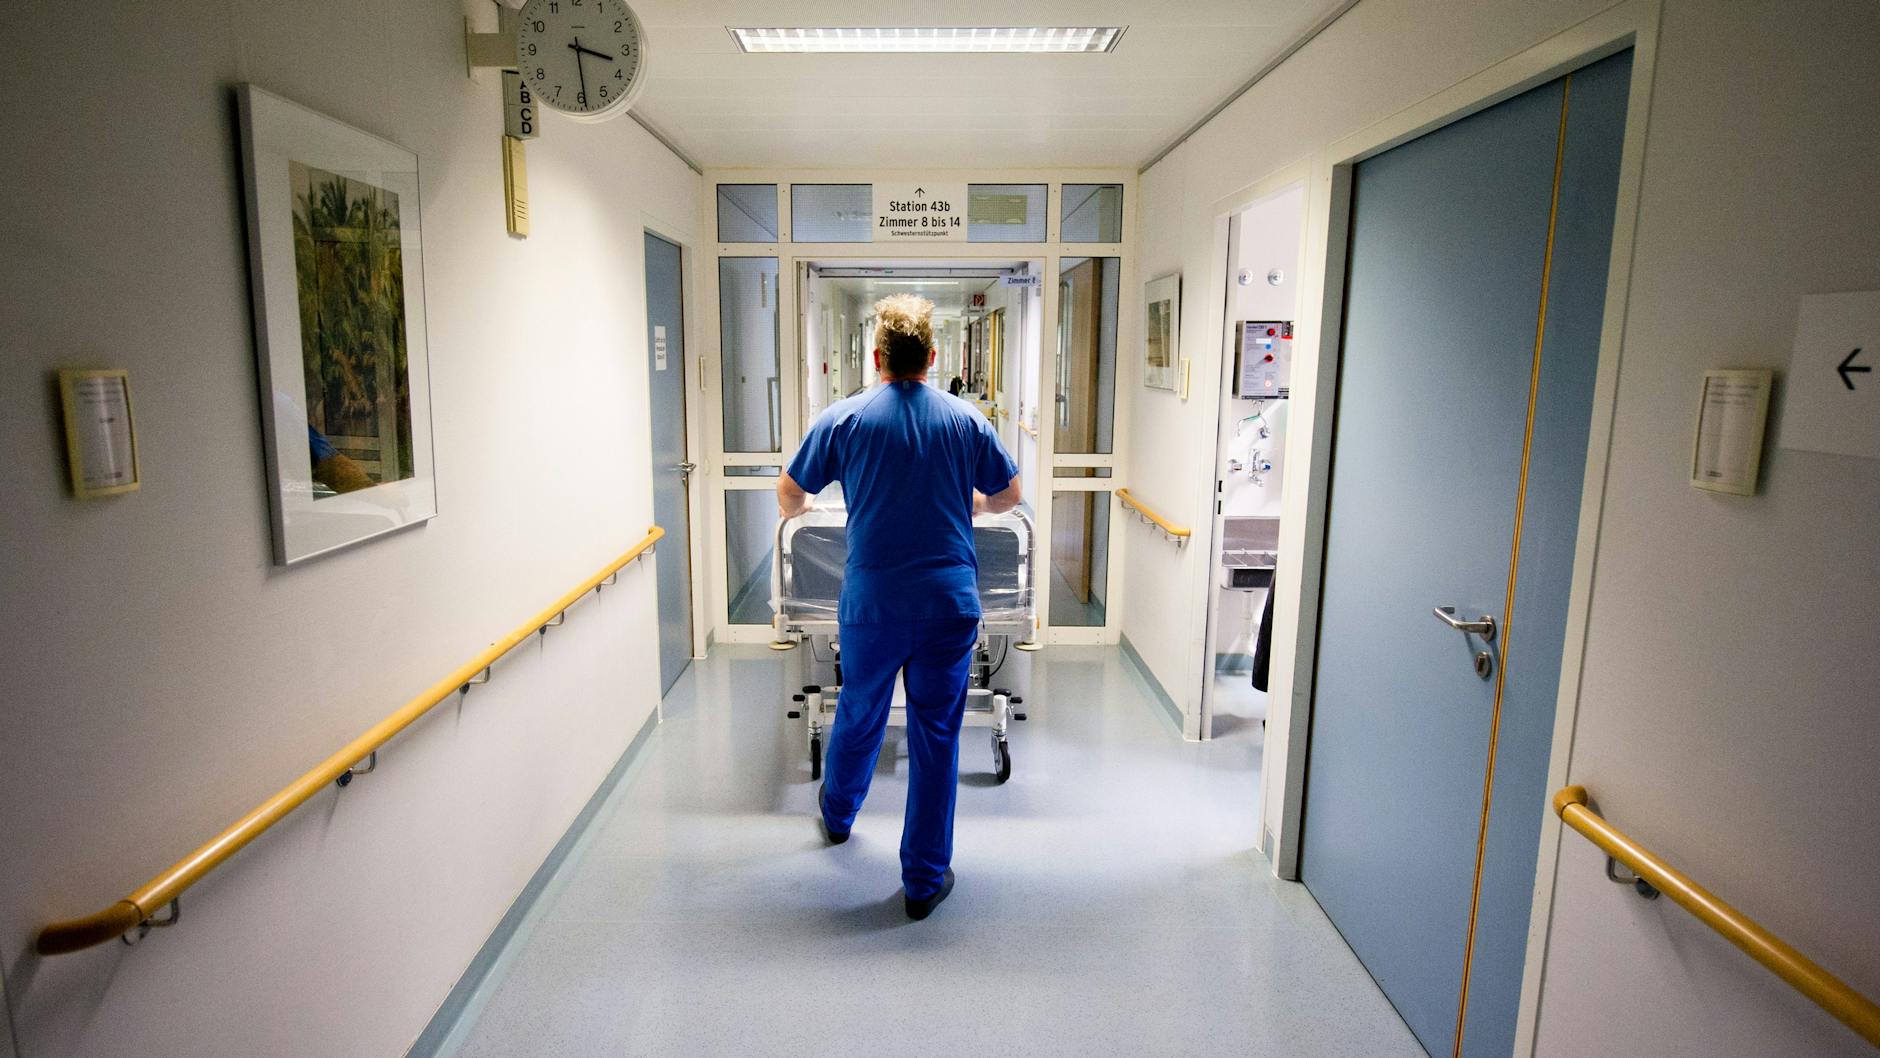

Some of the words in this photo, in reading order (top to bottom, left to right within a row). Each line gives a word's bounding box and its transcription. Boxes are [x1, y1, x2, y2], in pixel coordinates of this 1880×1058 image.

[549, 1, 559, 14] 11
[597, 1, 603, 14] 1
[532, 20, 545, 33] 10
[614, 20, 623, 33] 2
[528, 43, 537, 56] 9
[621, 43, 630, 56] 3
[536, 68, 545, 80] 8
[614, 68, 623, 80] 4
[520, 91, 531, 104] B
[554, 85, 562, 97] 7
[577, 91, 586, 104] 6
[599, 85, 608, 98] 5
[520, 108, 532, 121] C
[521, 121, 532, 134] D
[889, 200, 927, 212] Station
[930, 200, 951, 212] 43b
[879, 216, 918, 227] Zimmer
[921, 216, 928, 227] 8
[931, 216, 946, 227] bis
[949, 216, 960, 227] 14
